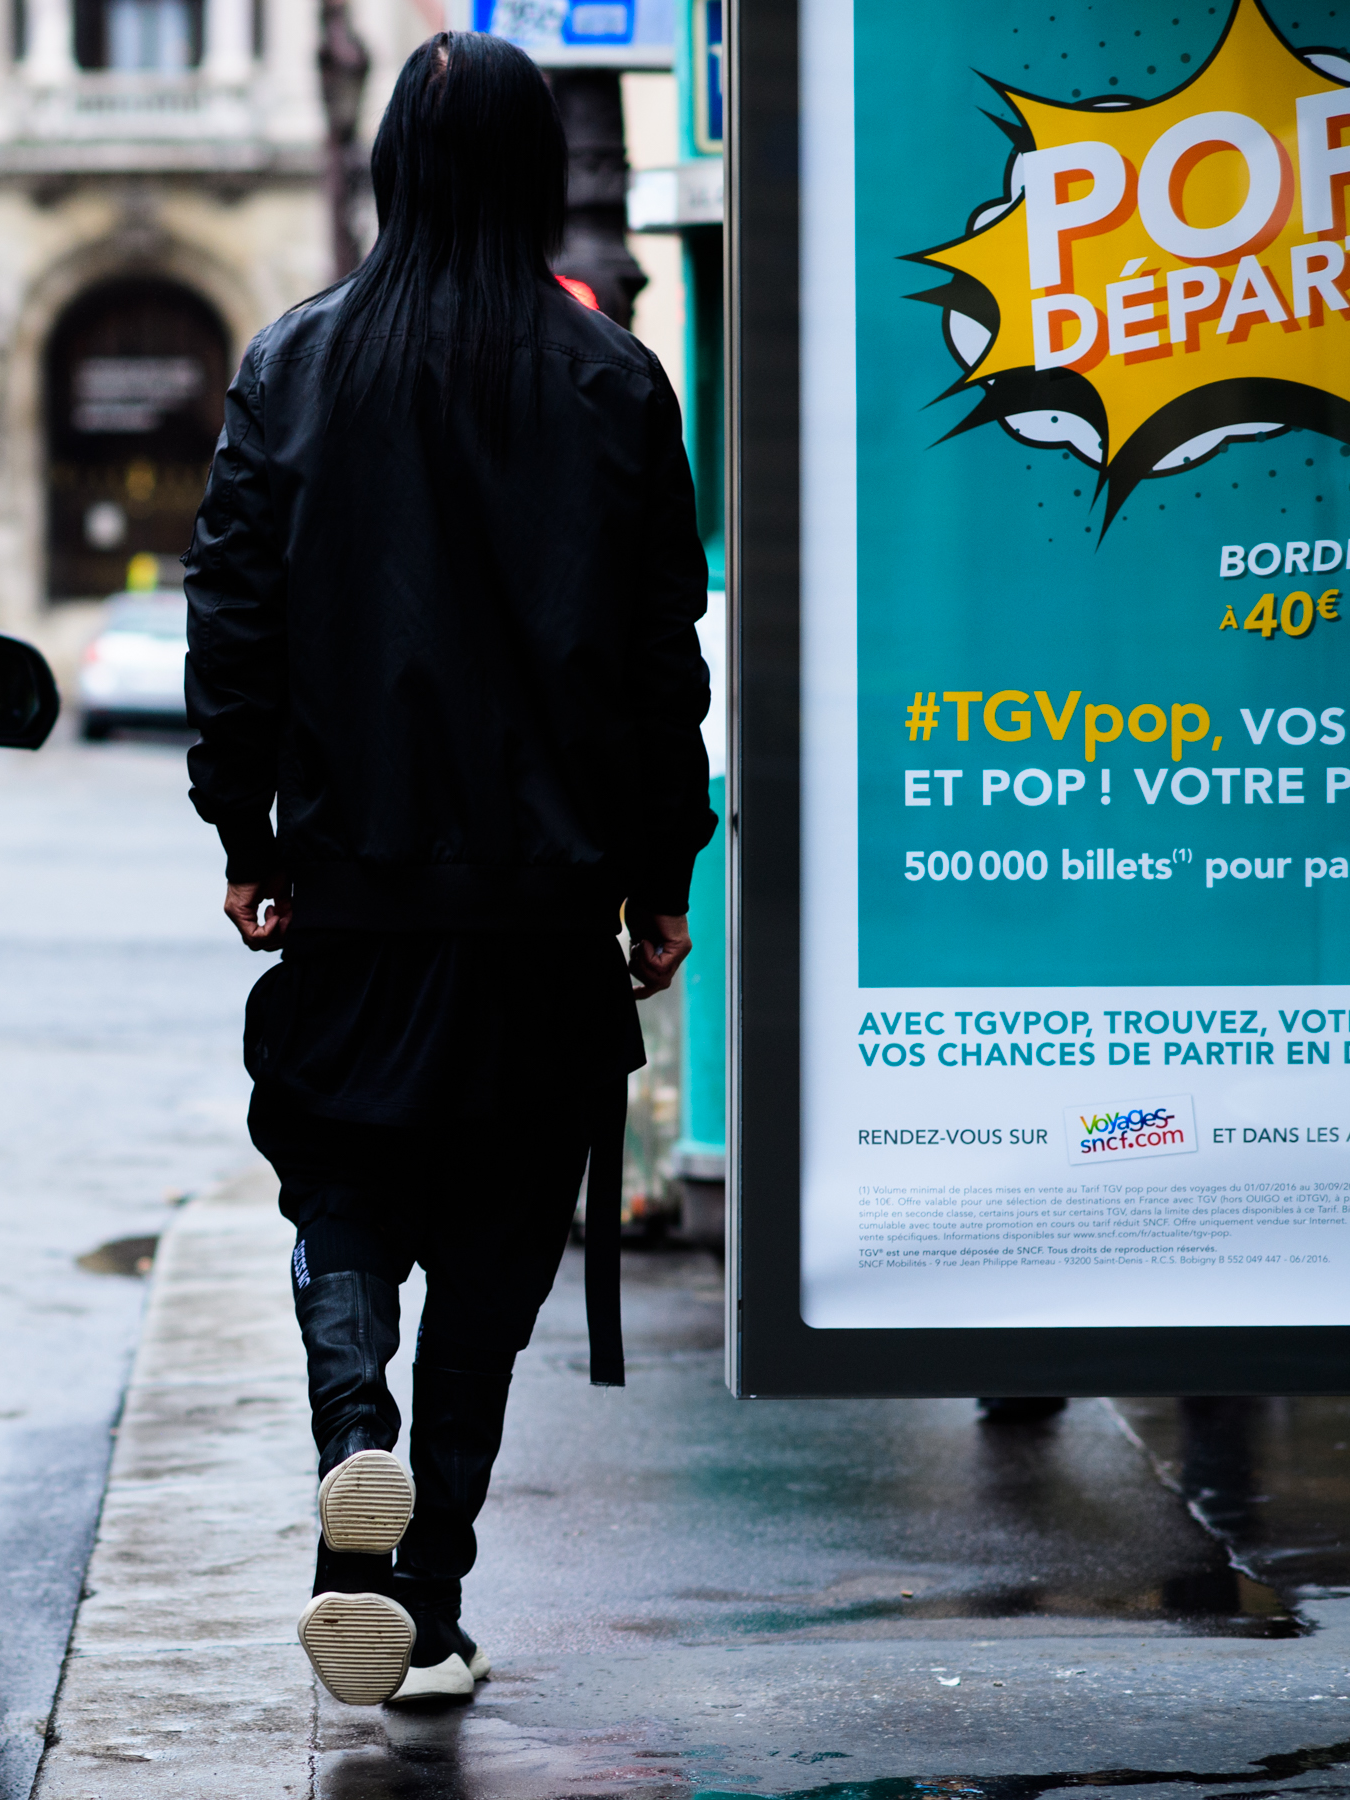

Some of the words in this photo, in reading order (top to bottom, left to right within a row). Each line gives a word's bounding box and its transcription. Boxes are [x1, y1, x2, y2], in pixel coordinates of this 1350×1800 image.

[1030, 235, 1350, 372] DÉPAR
[1219, 539, 1350, 578] BORD
[1219, 604, 1239, 631] À
[1243, 588, 1340, 638] 40€
[904, 689, 1223, 763] #TGVpop,
[1239, 707, 1346, 746] VOS
[904, 769, 964, 806] ET
[982, 767, 1086, 806] POP
[1133, 766, 1305, 805] VOTRE
[1205, 856, 1292, 888] pour
[857, 1011, 946, 1036] AVEC
[954, 1010, 1093, 1039] TGVPOP,
[1103, 1009, 1268, 1038] TROUVEZ,
[1278, 1009, 1350, 1034] VOT
[857, 1042, 927, 1067] VOS
[937, 1041, 1096, 1067] CHANCES
[1108, 1042, 1151, 1066] DE
[1163, 1041, 1275, 1066] PARTIR
[1286, 1041, 1331, 1065] EN
[857, 1128, 1003, 1146] RENDEZ-VOUS
[1008, 1128, 1049, 1145] SUR
[1212, 1127, 1237, 1144] ET
[1242, 1127, 1300, 1144] DANS
[1305, 1127, 1340, 1144] LES
[1079, 1126, 1185, 1154] sncf.com
